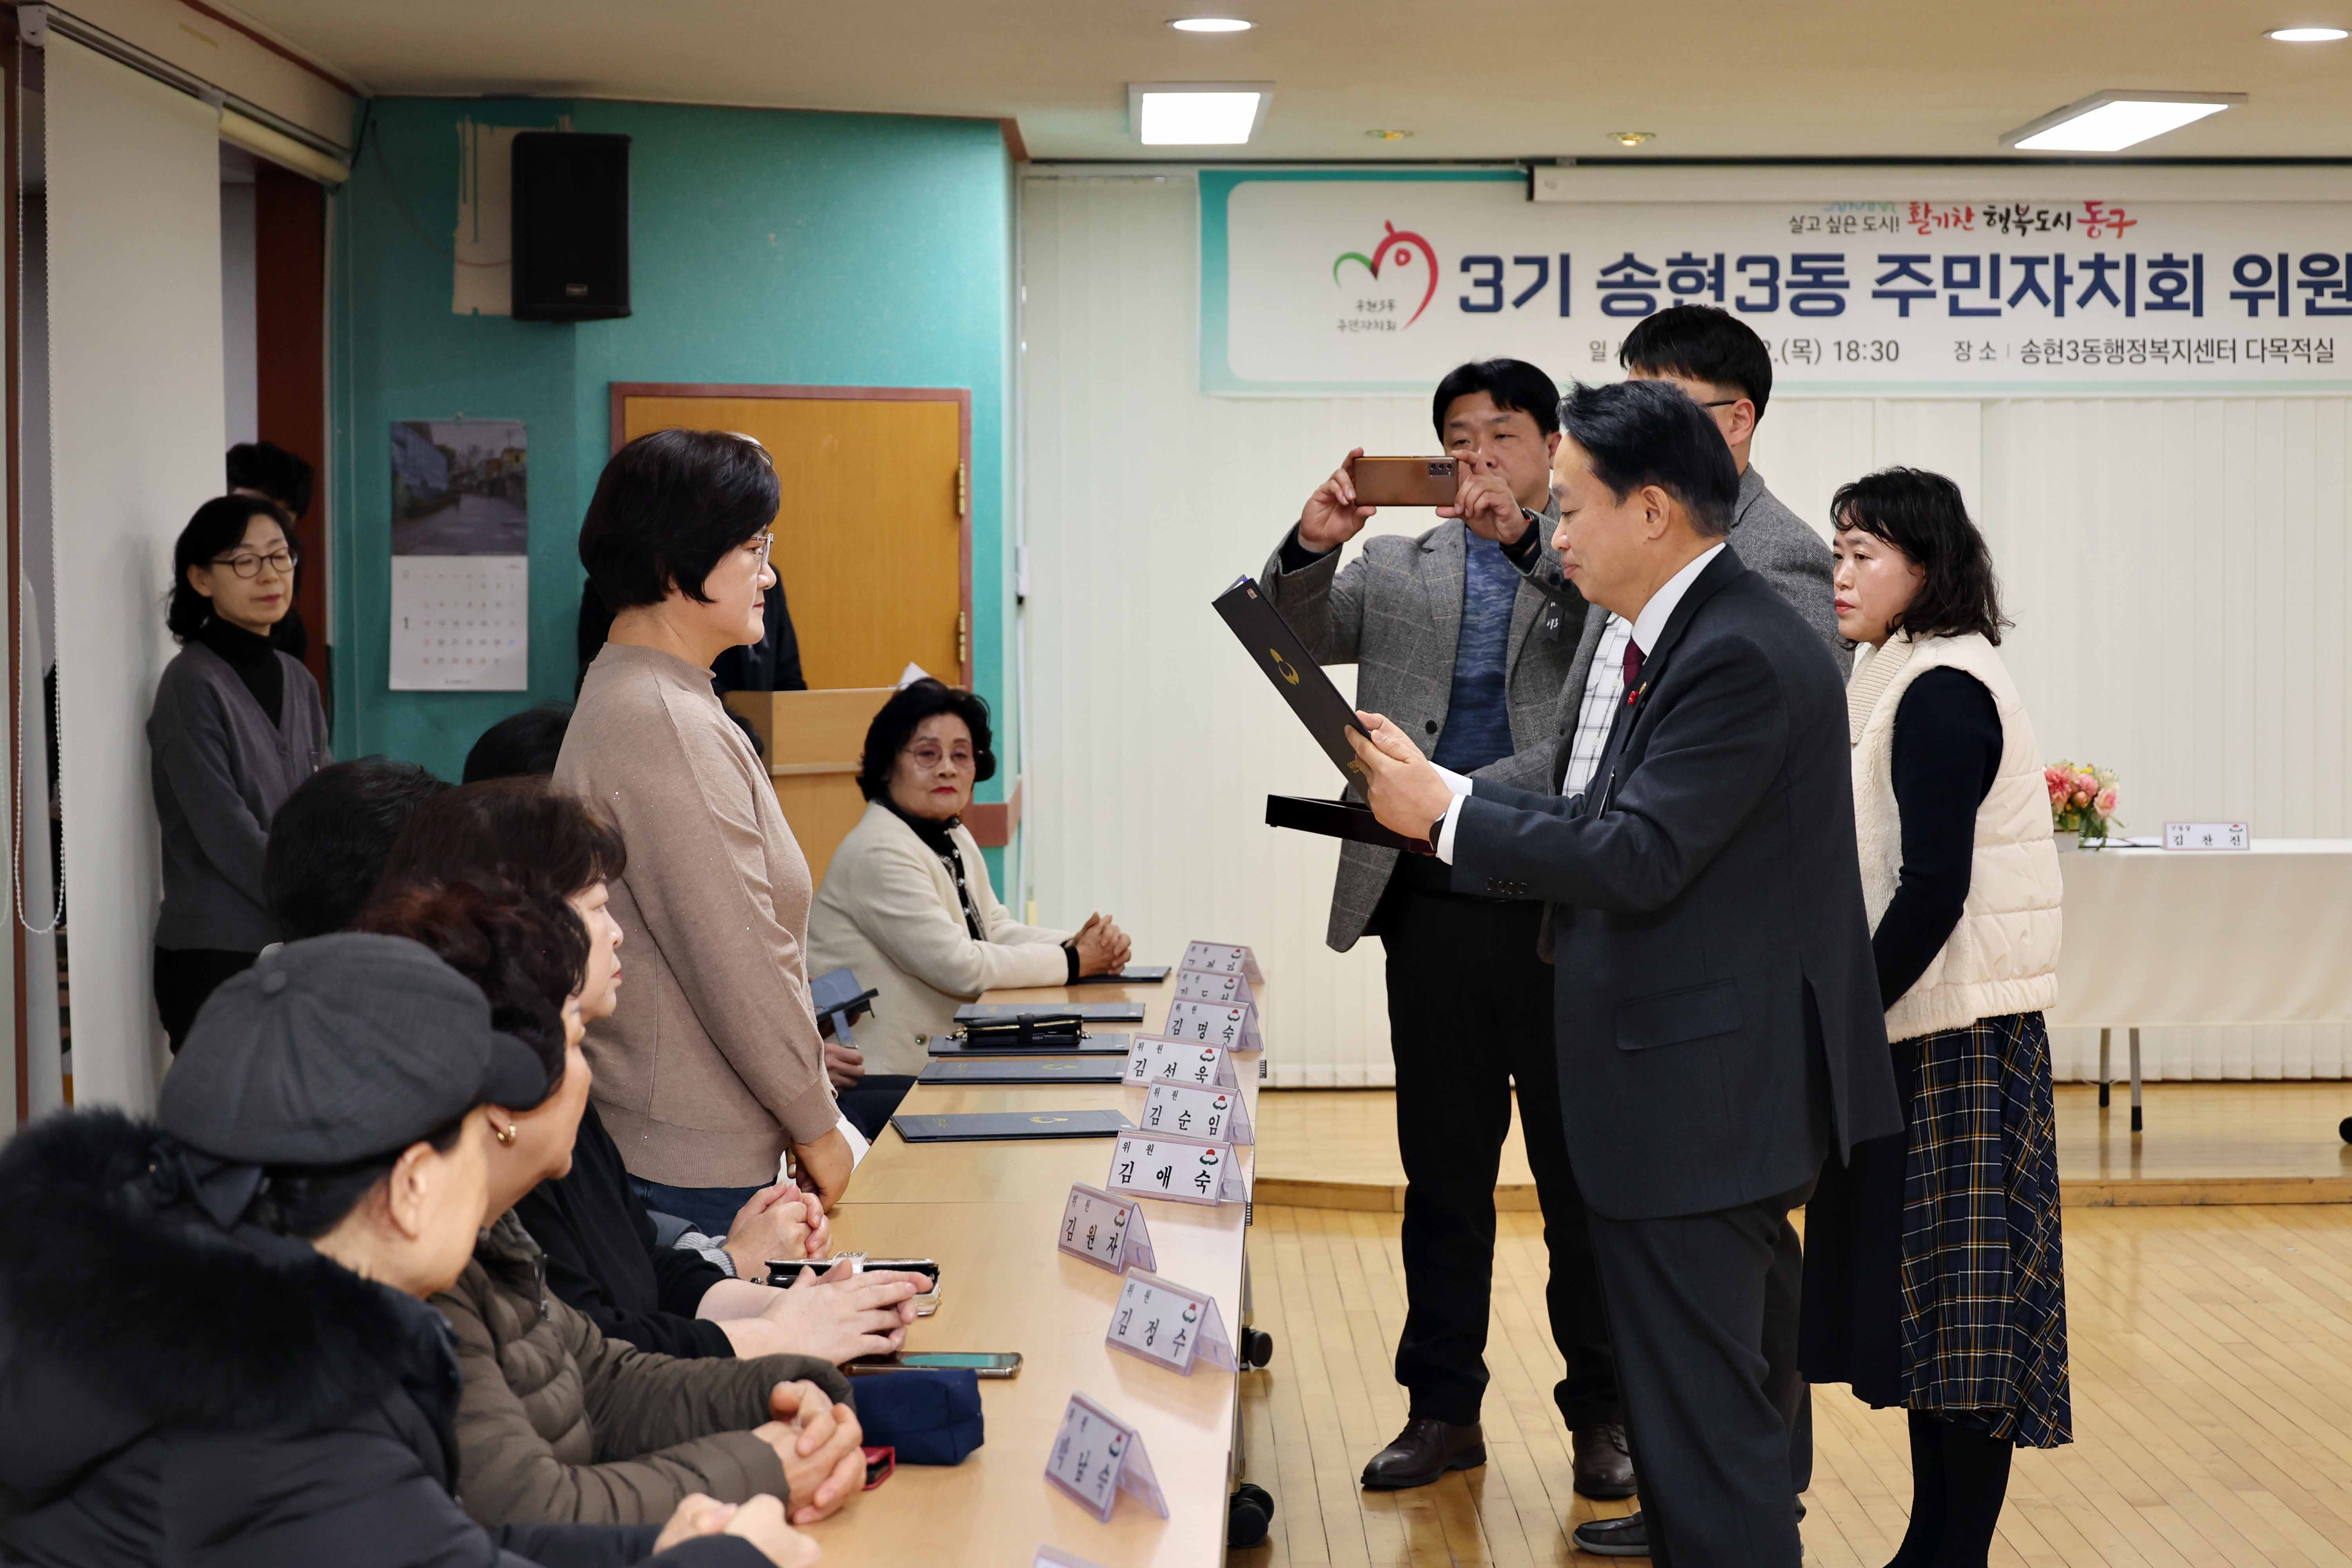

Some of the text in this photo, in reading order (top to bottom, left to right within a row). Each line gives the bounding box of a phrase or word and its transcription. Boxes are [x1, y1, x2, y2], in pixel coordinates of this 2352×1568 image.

[1826, 215, 1857, 234] 싶은
[1862, 216, 1899, 234] 도시!
[1907, 201, 1975, 235] 활기찬
[1983, 204, 2071, 237] 행복도시
[2076, 201, 2138, 239] 동구
[1460, 252, 2352, 318] 3기 송현3동 주민자치회 위원
[1833, 340, 1900, 362] 18:30
[2020, 338, 2237, 365] 송현3동행정복지센터
[2245, 338, 2334, 364] 다목적실
